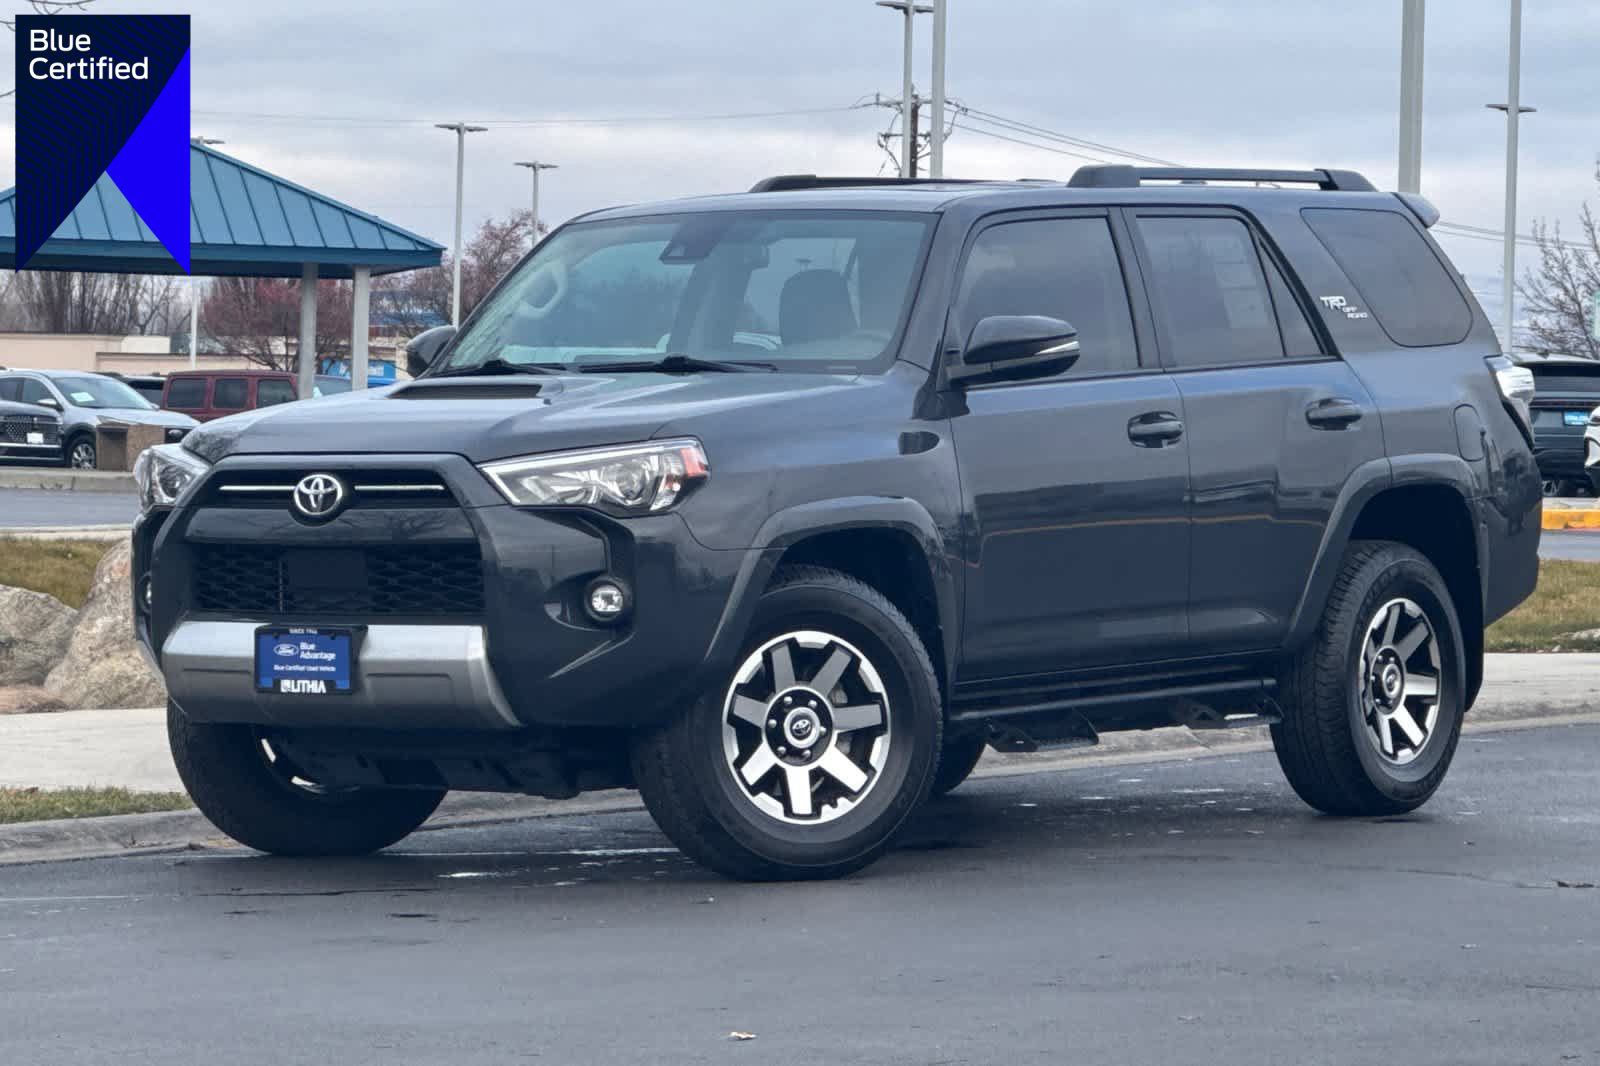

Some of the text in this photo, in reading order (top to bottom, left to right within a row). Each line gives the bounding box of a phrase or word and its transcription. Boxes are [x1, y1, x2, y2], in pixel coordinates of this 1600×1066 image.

[1319, 295, 1347, 310] TRD
[300, 642, 316, 650] Blue
[300, 652, 336, 661] Advantage
[291, 679, 326, 693] LITHIA
